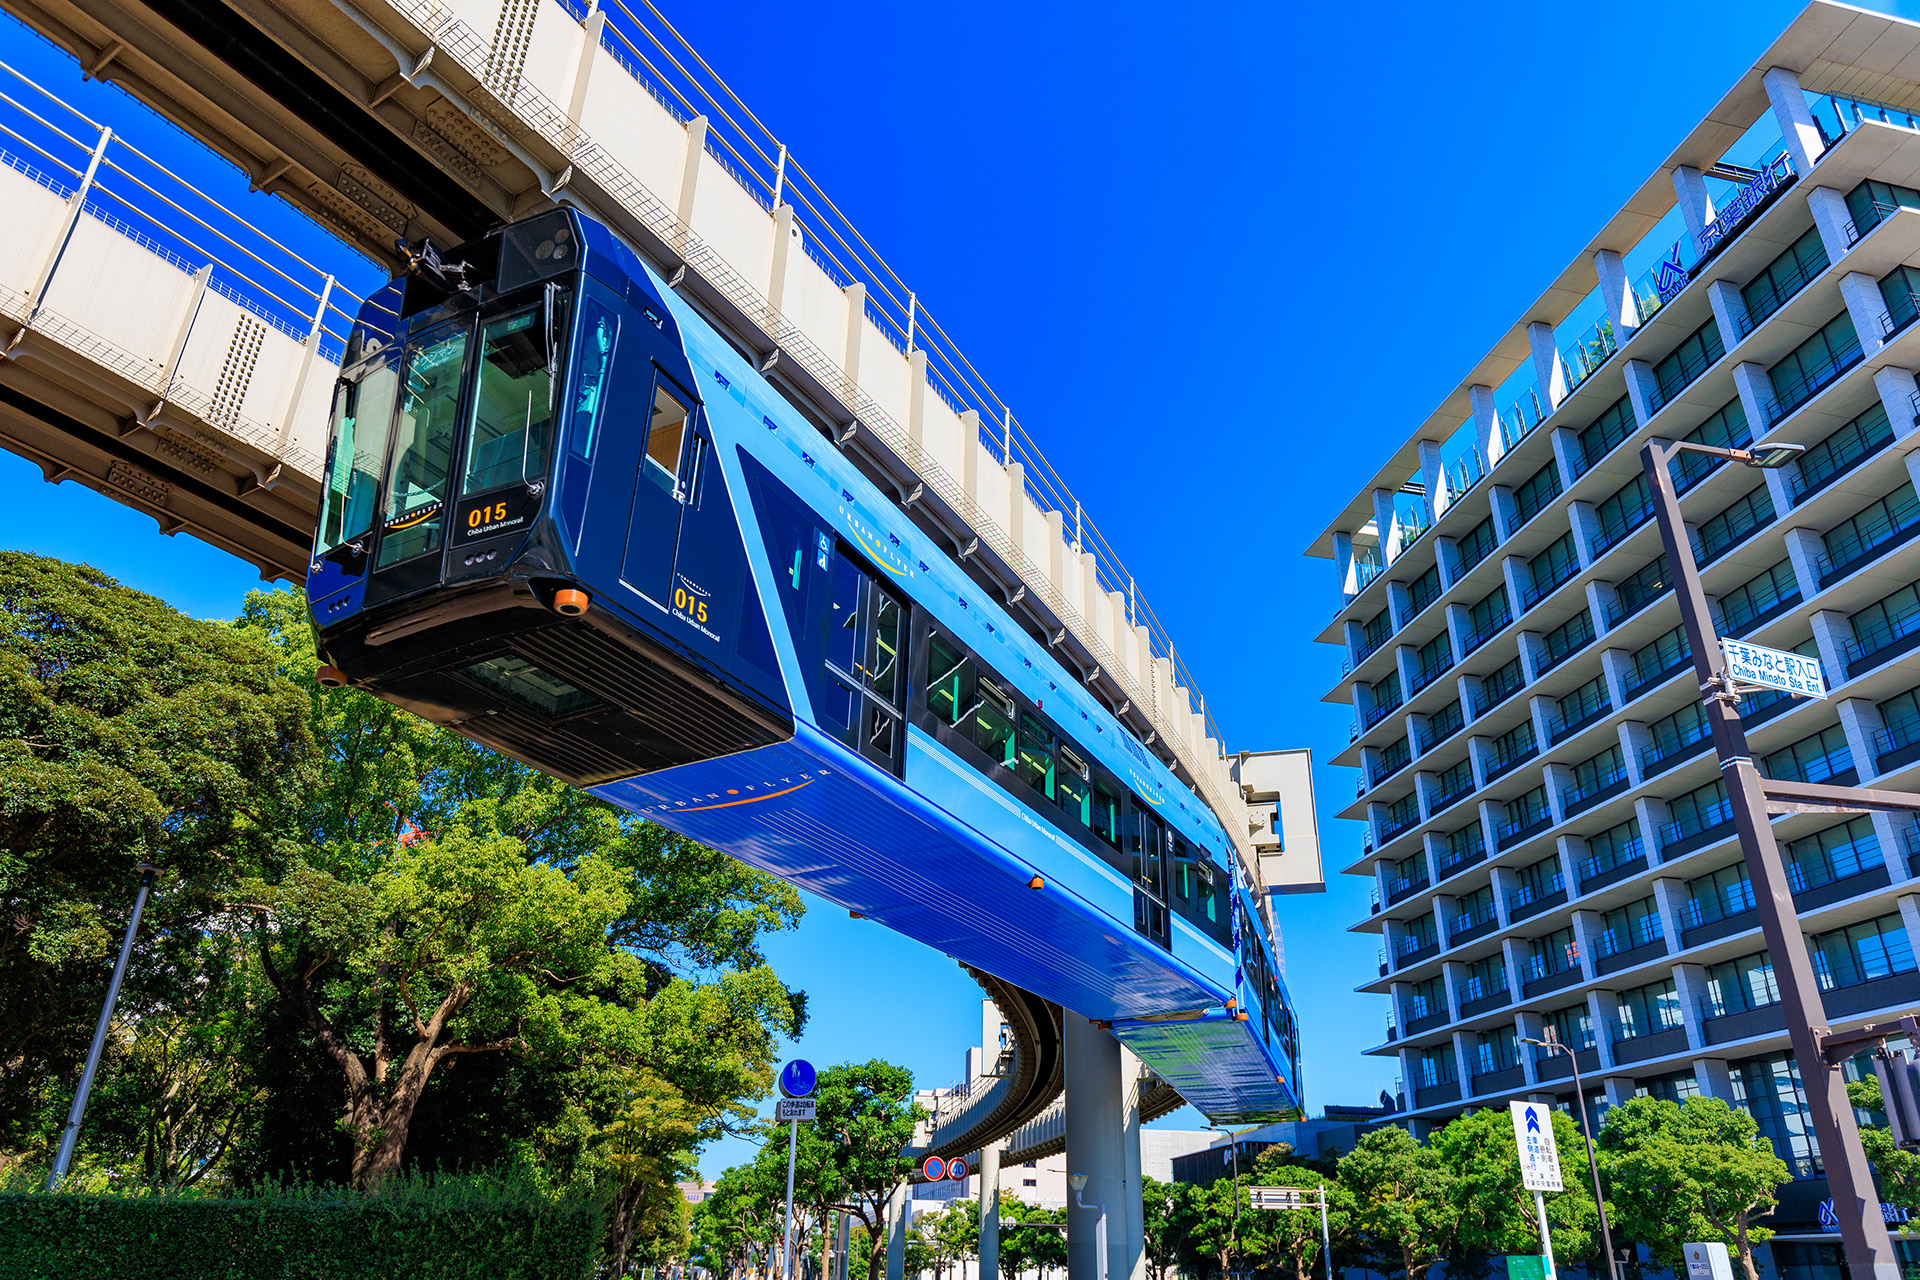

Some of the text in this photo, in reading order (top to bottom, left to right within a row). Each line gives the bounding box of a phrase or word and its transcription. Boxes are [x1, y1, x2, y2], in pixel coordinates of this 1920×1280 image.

[1697, 150, 1792, 255] 京葉銀行
[1661, 273, 1690, 305] BANK
[467, 516, 524, 537] Chiba Urban Monorail
[468, 502, 507, 527] 015
[839, 505, 914, 578] URBAN FLYER
[674, 588, 708, 623] 015
[672, 608, 720, 642] Chiba Urban Monorail
[1728, 644, 1819, 681] 千葉みなと駅入口
[1732, 664, 1757, 679] Chiba
[1759, 670, 1786, 686] Minato
[1789, 677, 1805, 690] Sta.
[641, 769, 831, 814] URBAN FLYER
[952, 1164, 965, 1175] 40
